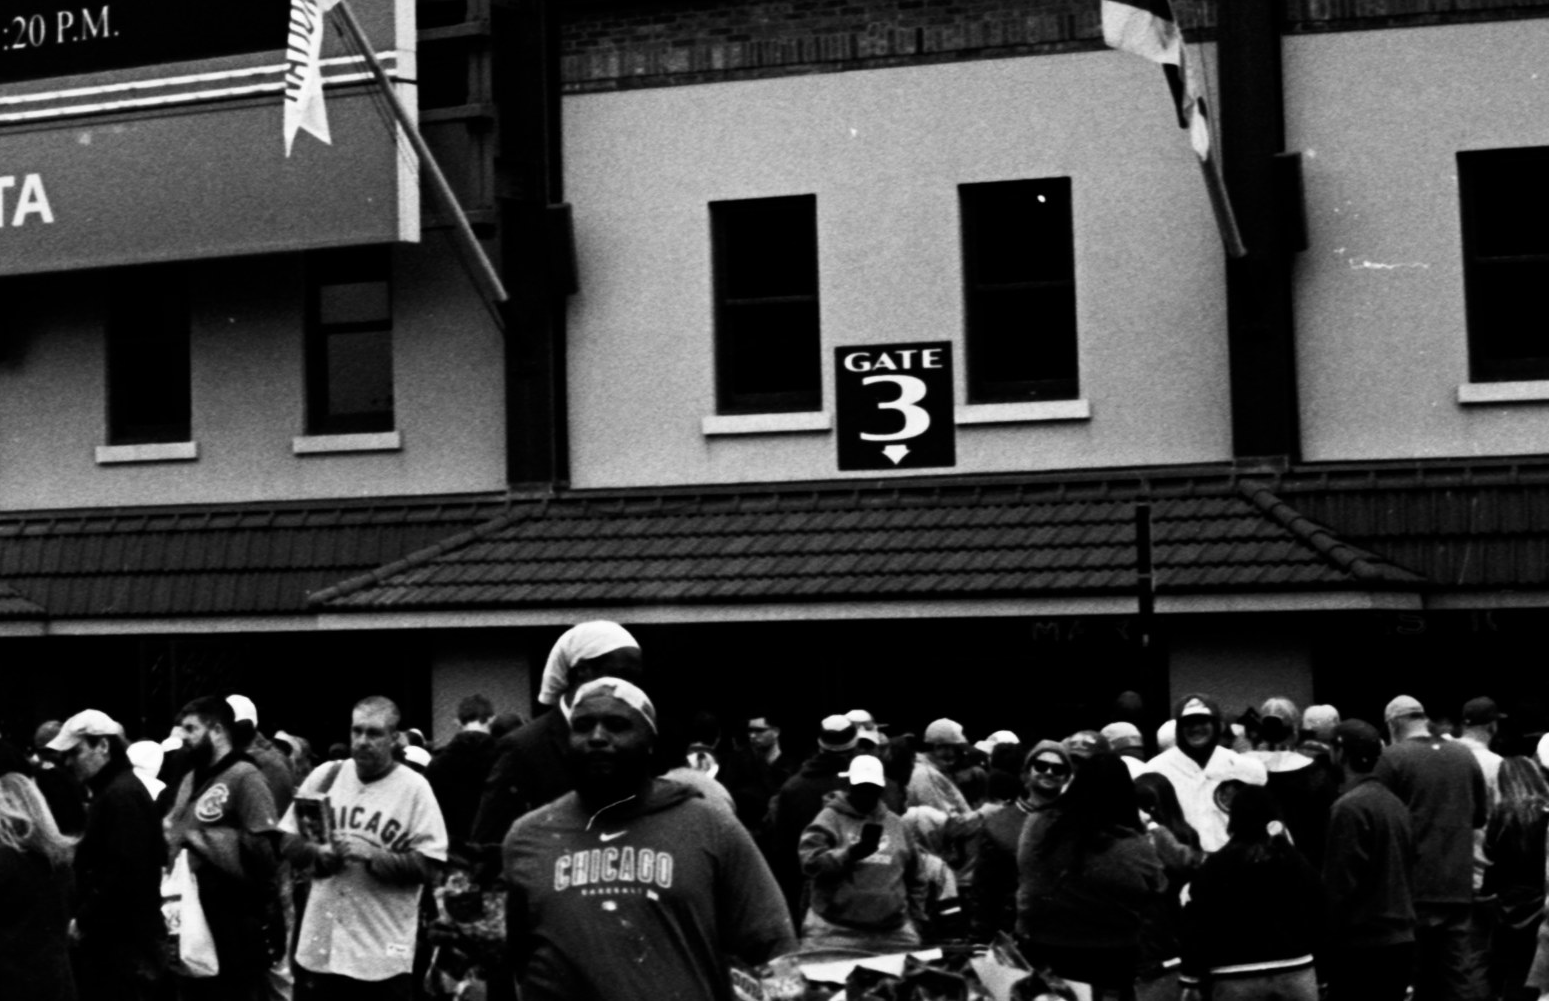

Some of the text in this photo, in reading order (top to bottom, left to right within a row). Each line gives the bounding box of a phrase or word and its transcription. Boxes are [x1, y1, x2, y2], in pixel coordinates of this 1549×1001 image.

[55, 5, 120, 44] P.M.
[844, 348, 943, 372] GATE
[859, 374, 931, 441] 3
[329, 805, 414, 854] ICAGO
[554, 846, 674, 892] CHICAGO
